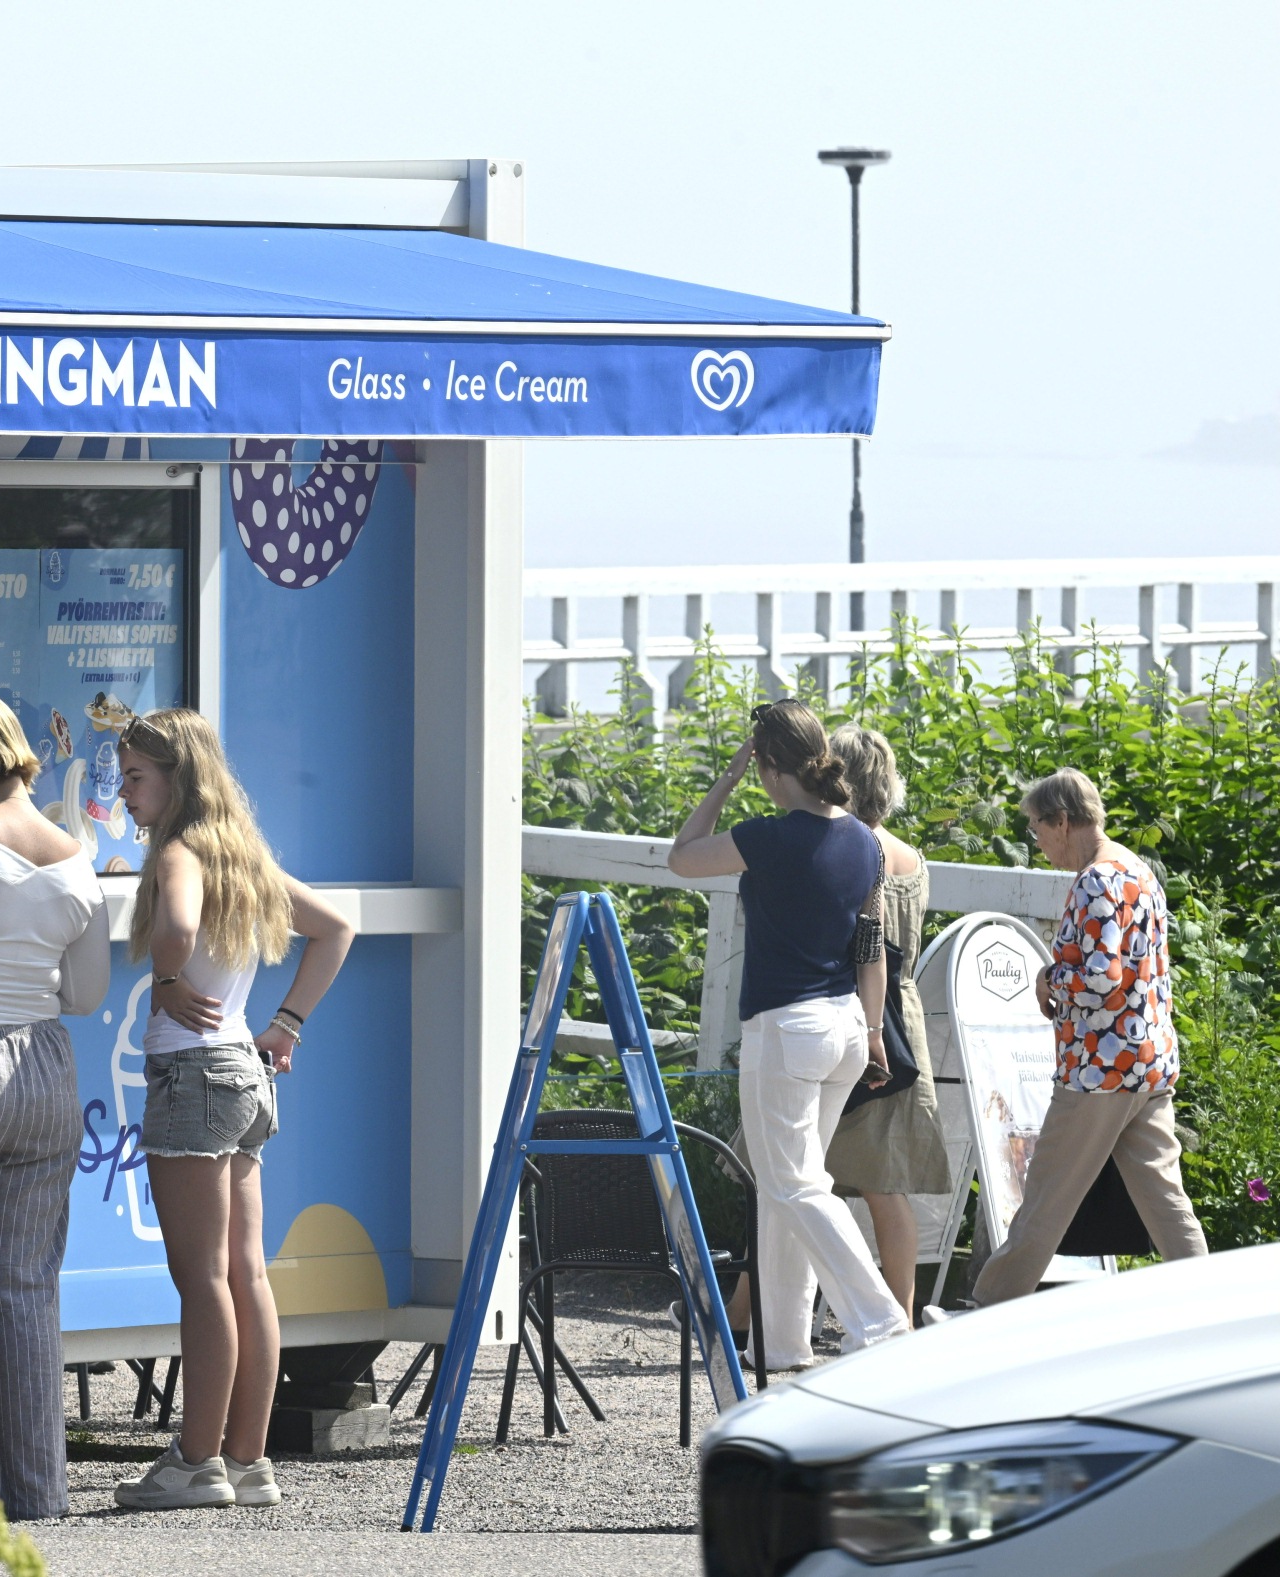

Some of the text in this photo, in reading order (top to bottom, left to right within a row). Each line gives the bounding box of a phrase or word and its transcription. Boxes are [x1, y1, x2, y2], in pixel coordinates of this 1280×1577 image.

[327, 358, 407, 402] Glass
[446, 359, 590, 404] Ice Cream
[127, 563, 177, 591] 7,50 €
[56, 598, 167, 622] PYÖRREMYRSKY:
[131, 624, 178, 644] SOFTIS
[76, 648, 86, 668] 2
[983, 958, 1023, 985] Paulig
